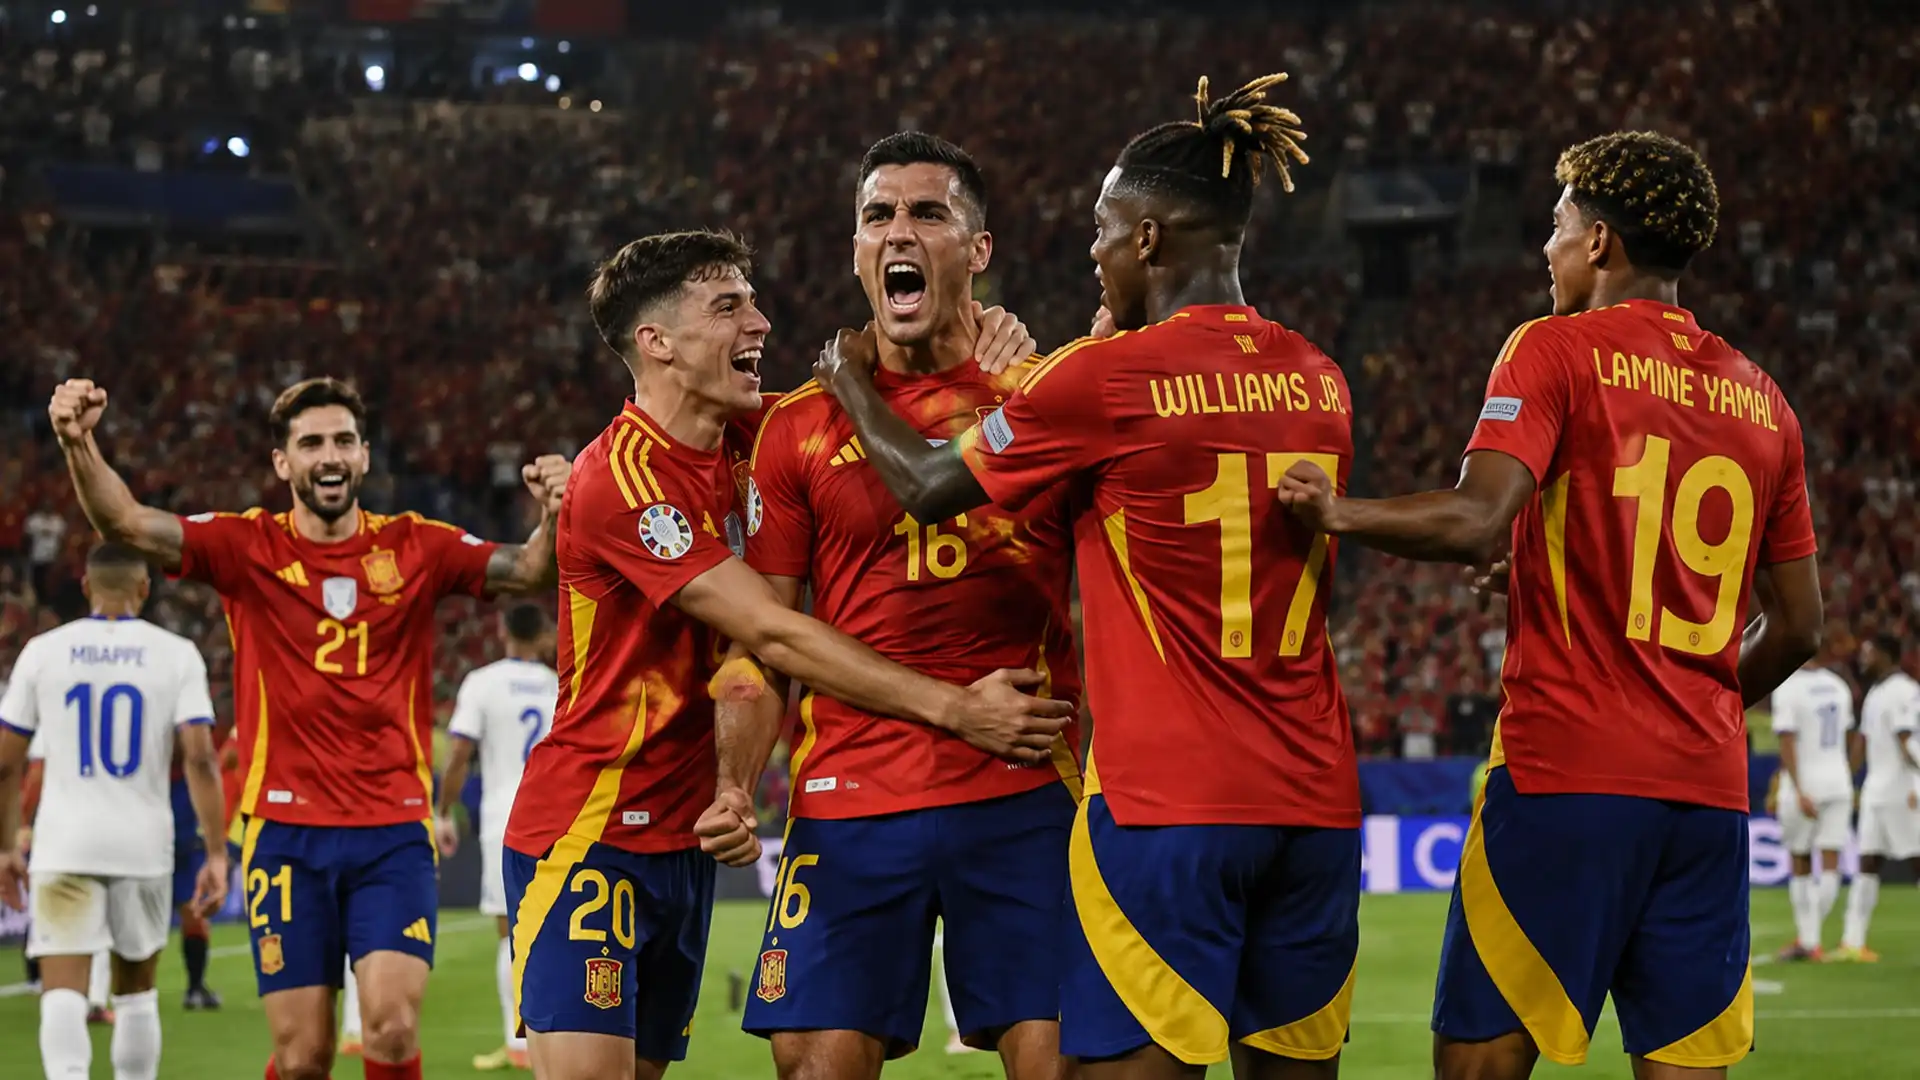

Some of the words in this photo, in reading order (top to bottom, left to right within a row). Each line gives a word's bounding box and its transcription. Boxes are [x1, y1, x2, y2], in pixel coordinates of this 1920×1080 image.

[1150, 372, 1310, 418] WILLIAMS
[1318, 374, 1346, 415] JR.
[1593, 348, 1694, 407] LAMINE
[1702, 374, 1778, 432] YAMAL
[894, 512, 967, 580] 16
[1184, 452, 1339, 658] 17
[1612, 434, 1754, 656] 19
[314, 618, 368, 675] 21
[65, 683, 143, 778] 10
[248, 864, 292, 929] 21
[568, 868, 636, 950] 20
[767, 854, 820, 934] 16
